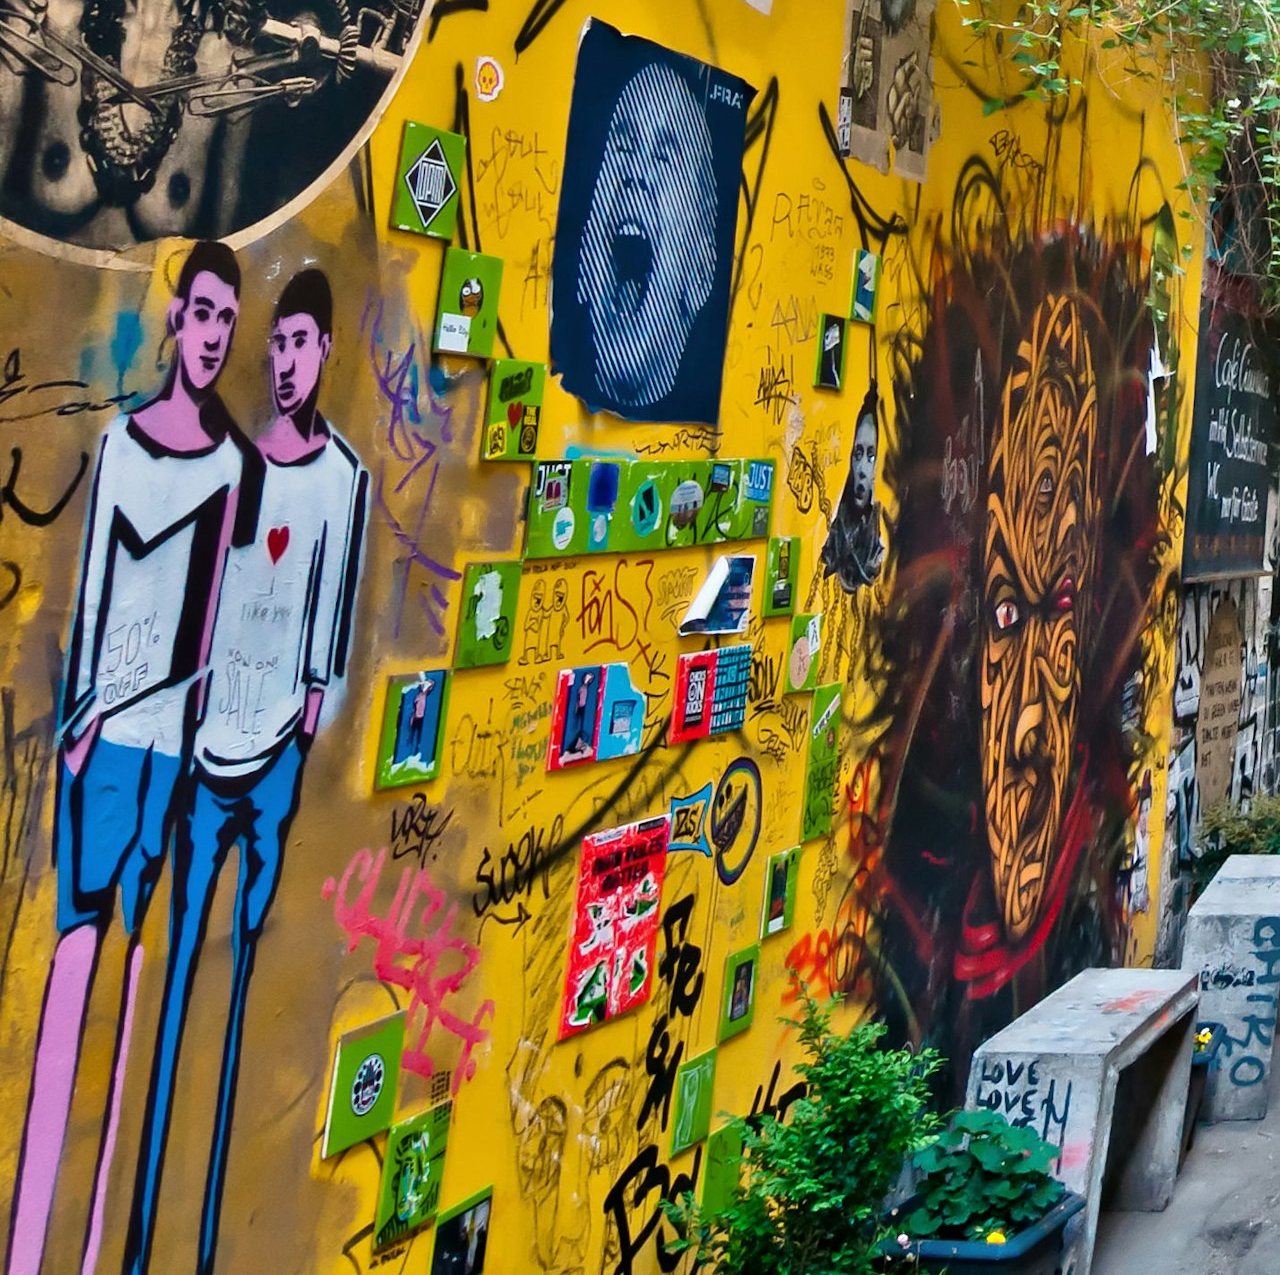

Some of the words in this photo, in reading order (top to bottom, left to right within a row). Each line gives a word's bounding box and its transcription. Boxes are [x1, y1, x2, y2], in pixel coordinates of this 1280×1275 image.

[749, 462, 774, 490] JUST
[1207, 462, 1221, 500] WC
[102, 610, 161, 675] 50%
[103, 662, 150, 705] OFF
[219, 661, 274, 735] SALE
[688, 681, 706, 702] ON
[981, 1060, 1041, 1086] LOVE
[976, 1089, 1036, 1115] LOVE
